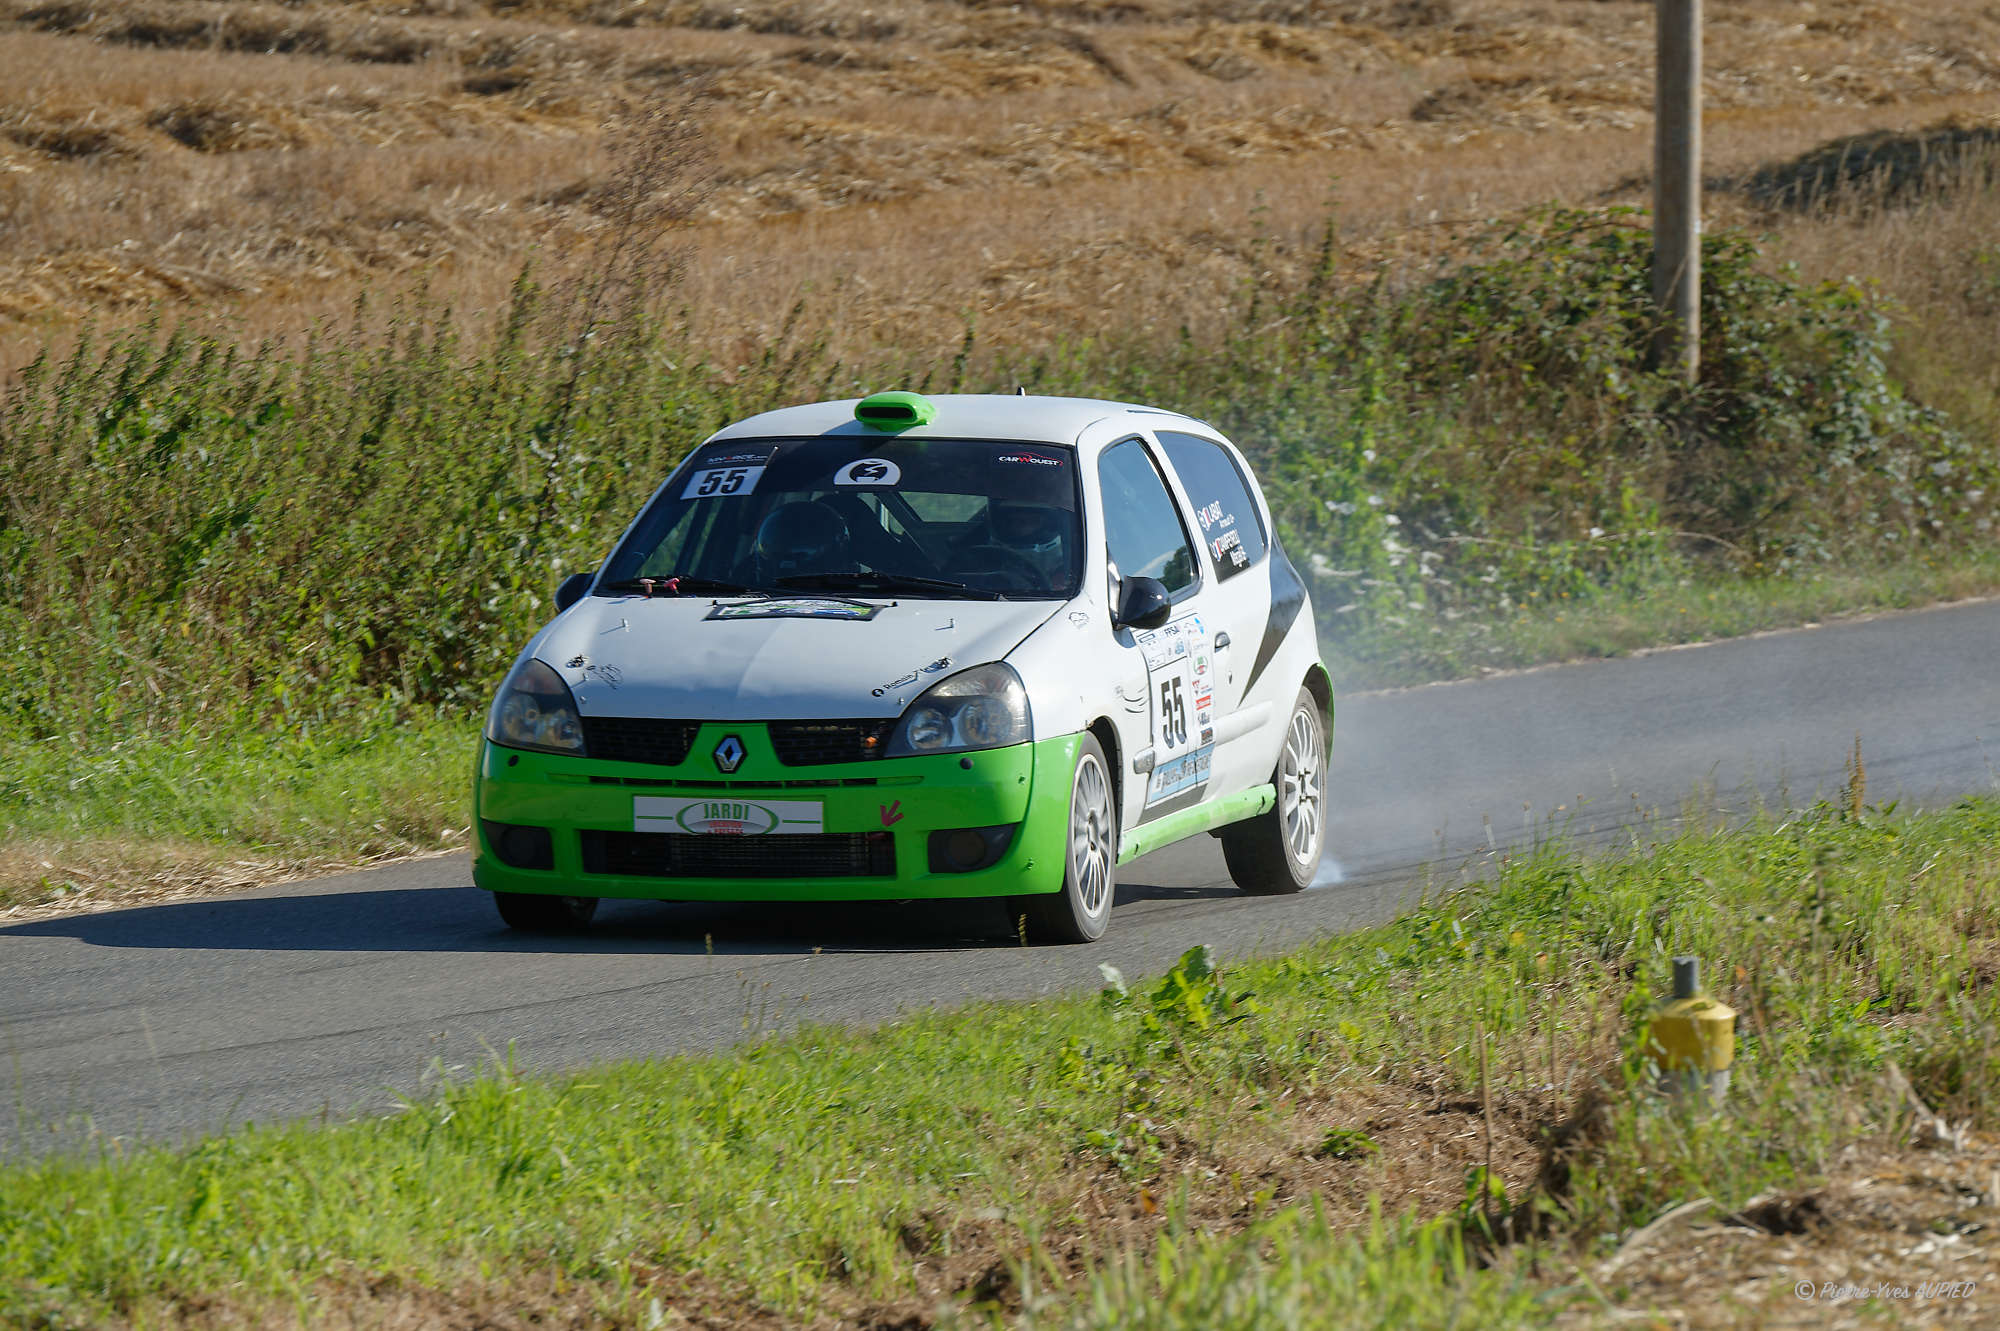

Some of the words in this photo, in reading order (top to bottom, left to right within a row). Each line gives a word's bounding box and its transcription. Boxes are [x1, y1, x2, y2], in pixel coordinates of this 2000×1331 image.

[698, 469, 748, 495] 55
[1161, 675, 1187, 749] 55
[704, 803, 750, 820] JARDI
